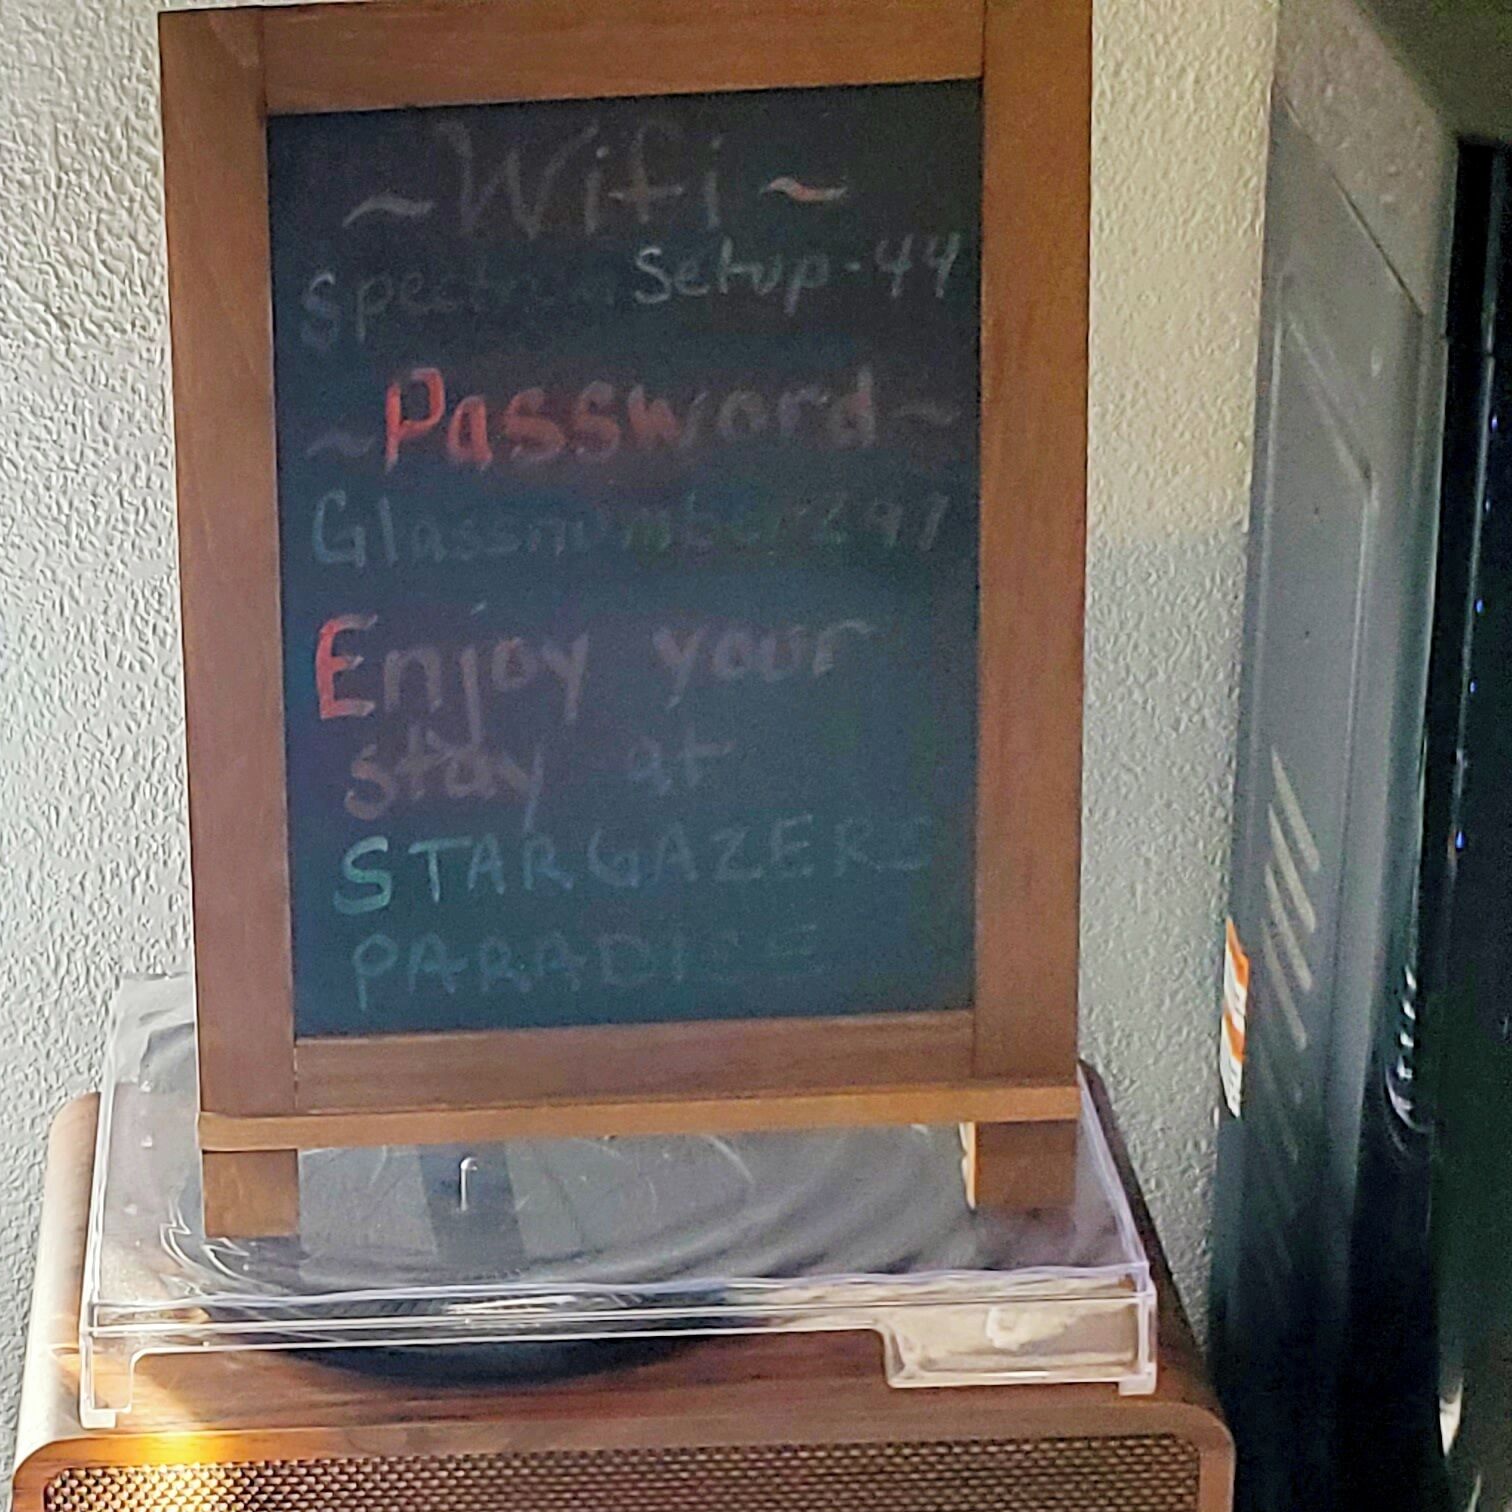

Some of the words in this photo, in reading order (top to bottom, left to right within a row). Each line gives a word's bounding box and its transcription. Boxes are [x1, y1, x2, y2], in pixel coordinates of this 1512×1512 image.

[383, 365, 877, 473] Password
[315, 603, 590, 748] Enjoy
[654, 618, 875, 713] your
